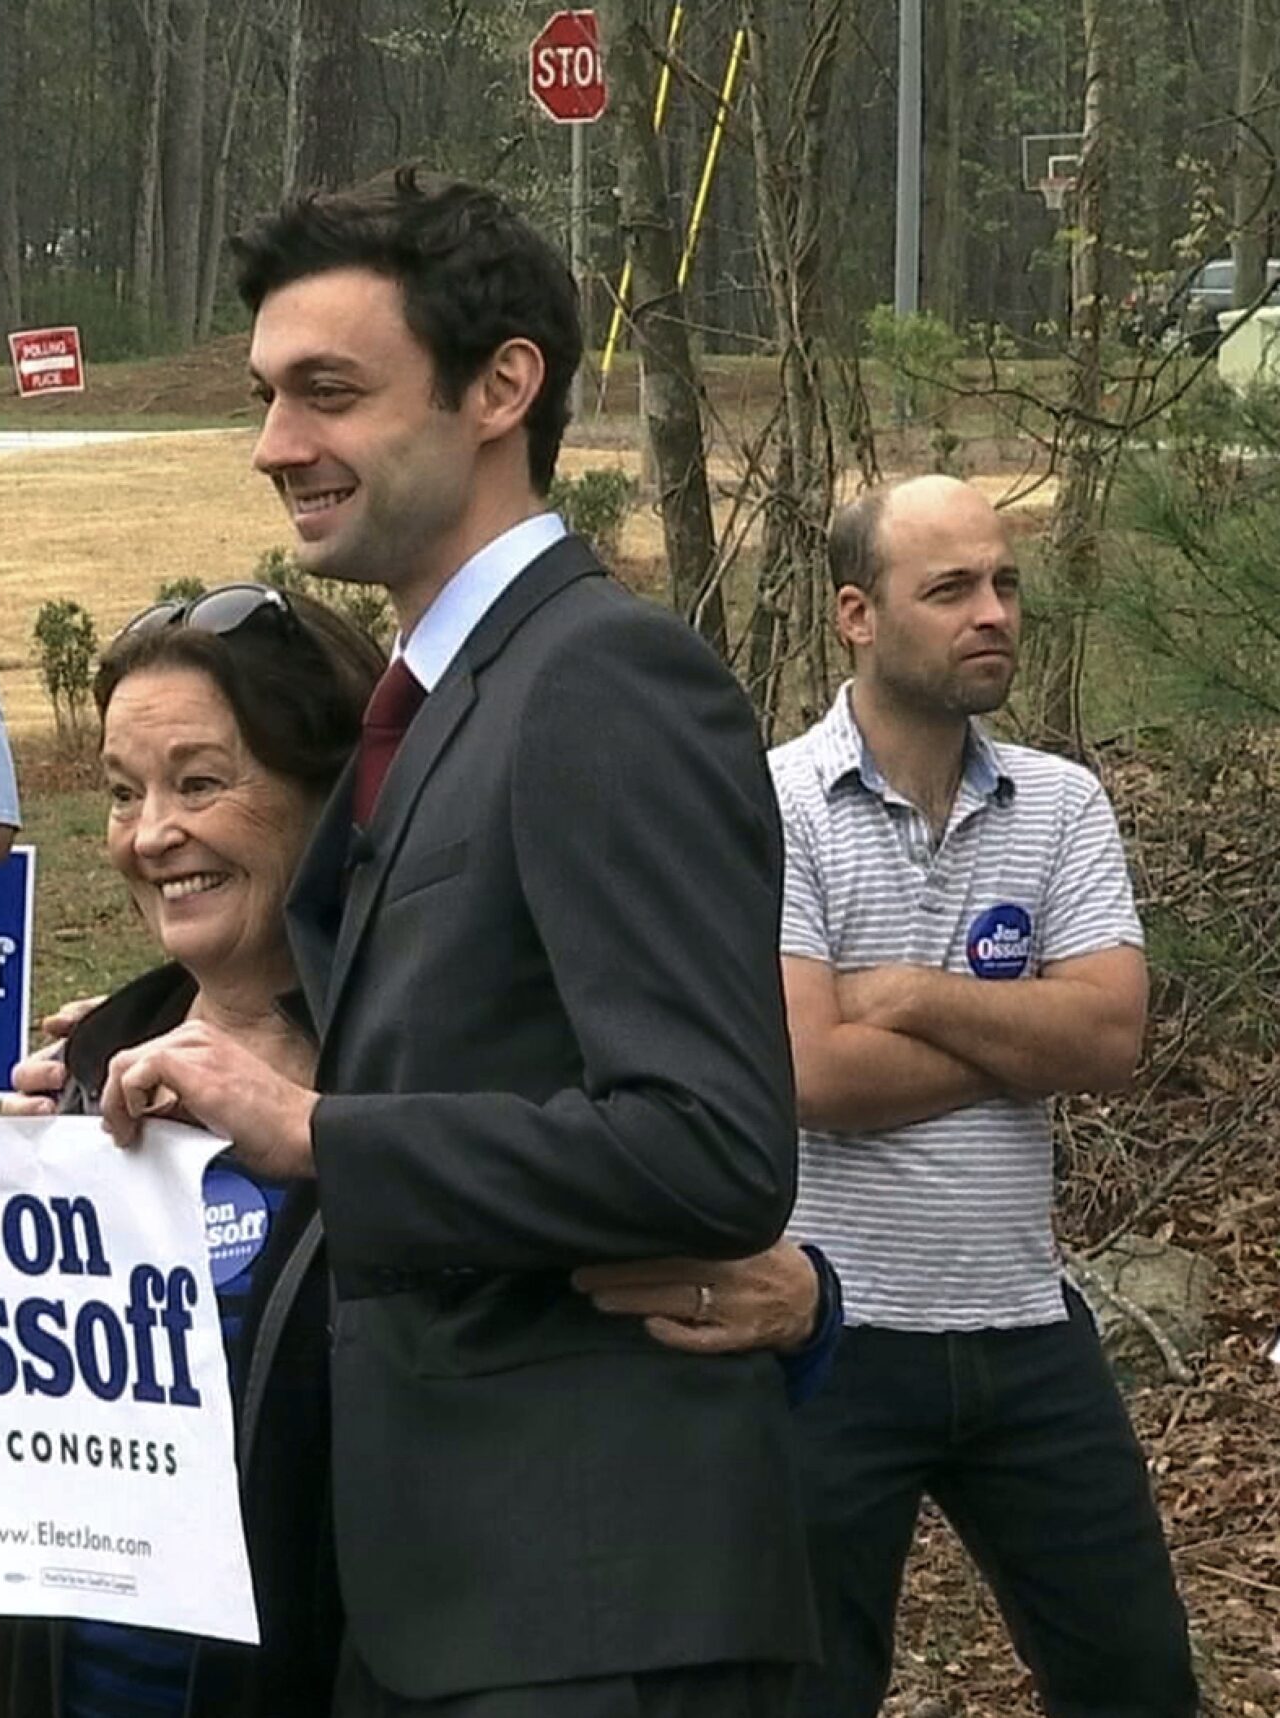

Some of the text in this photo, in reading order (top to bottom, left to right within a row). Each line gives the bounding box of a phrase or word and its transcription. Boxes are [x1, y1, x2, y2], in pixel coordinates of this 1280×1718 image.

[537, 46, 603, 88] STO
[23, 340, 66, 358] POLLING
[205, 1203, 235, 1223] on
[207, 1209, 266, 1247] soff
[7, 1430, 178, 1476] CONGRESS
